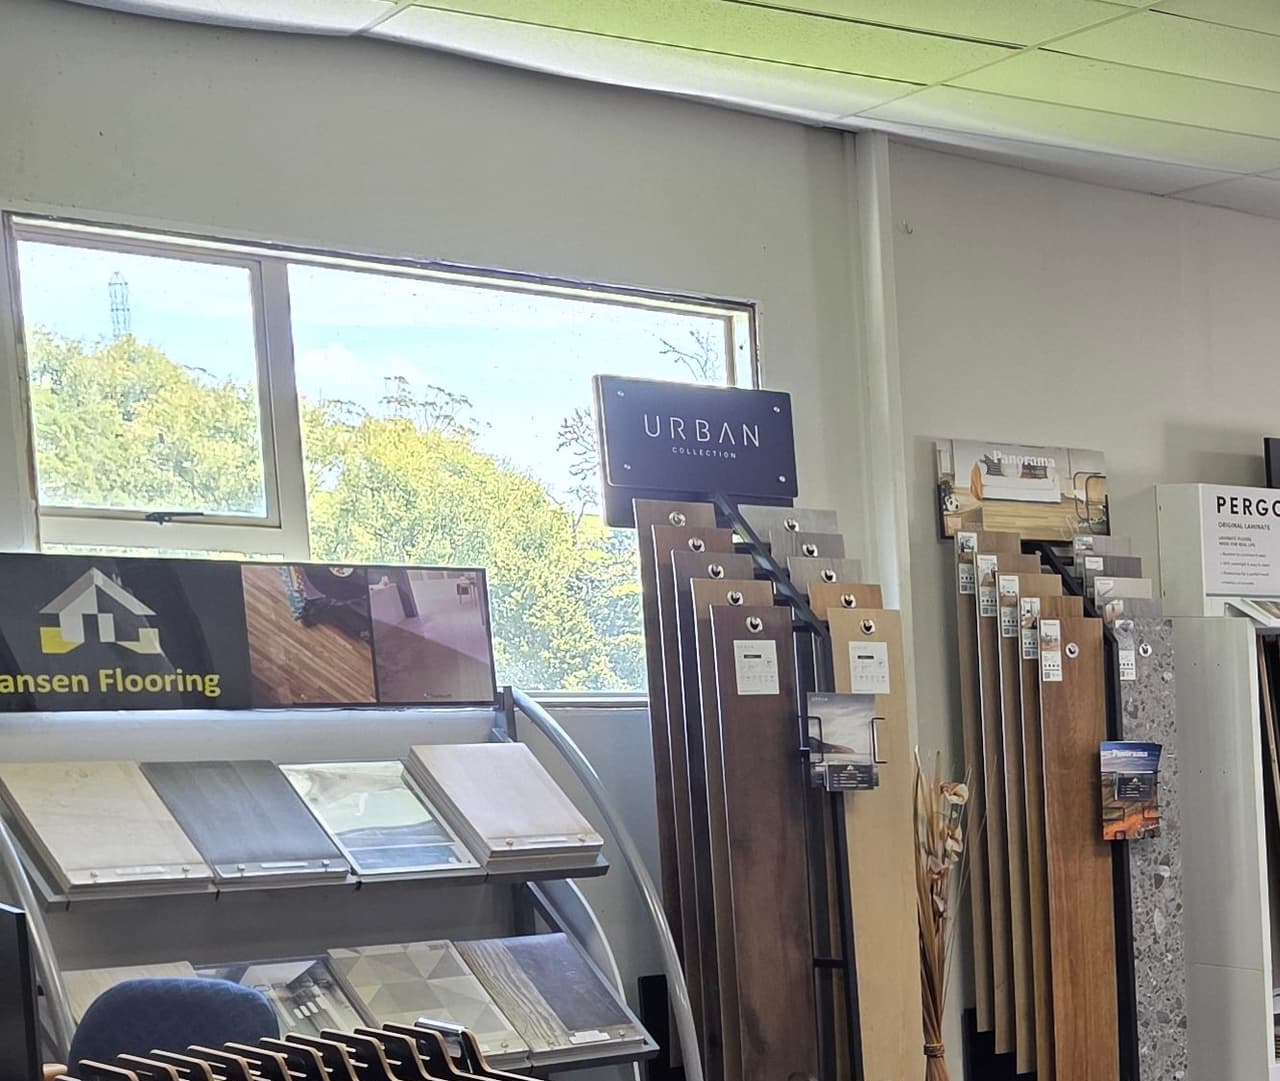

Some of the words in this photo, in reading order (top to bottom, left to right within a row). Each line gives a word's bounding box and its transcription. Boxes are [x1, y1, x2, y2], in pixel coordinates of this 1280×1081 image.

[643, 413, 760, 448] URBAN
[672, 446, 737, 459] COLLECTION
[992, 450, 1056, 467] Panorama
[1218, 522, 1242, 530] ORIGINAL
[1244, 523, 1270, 531] LAMINATE
[0, 673, 89, 694] ansen
[99, 667, 221, 697] Flooring
